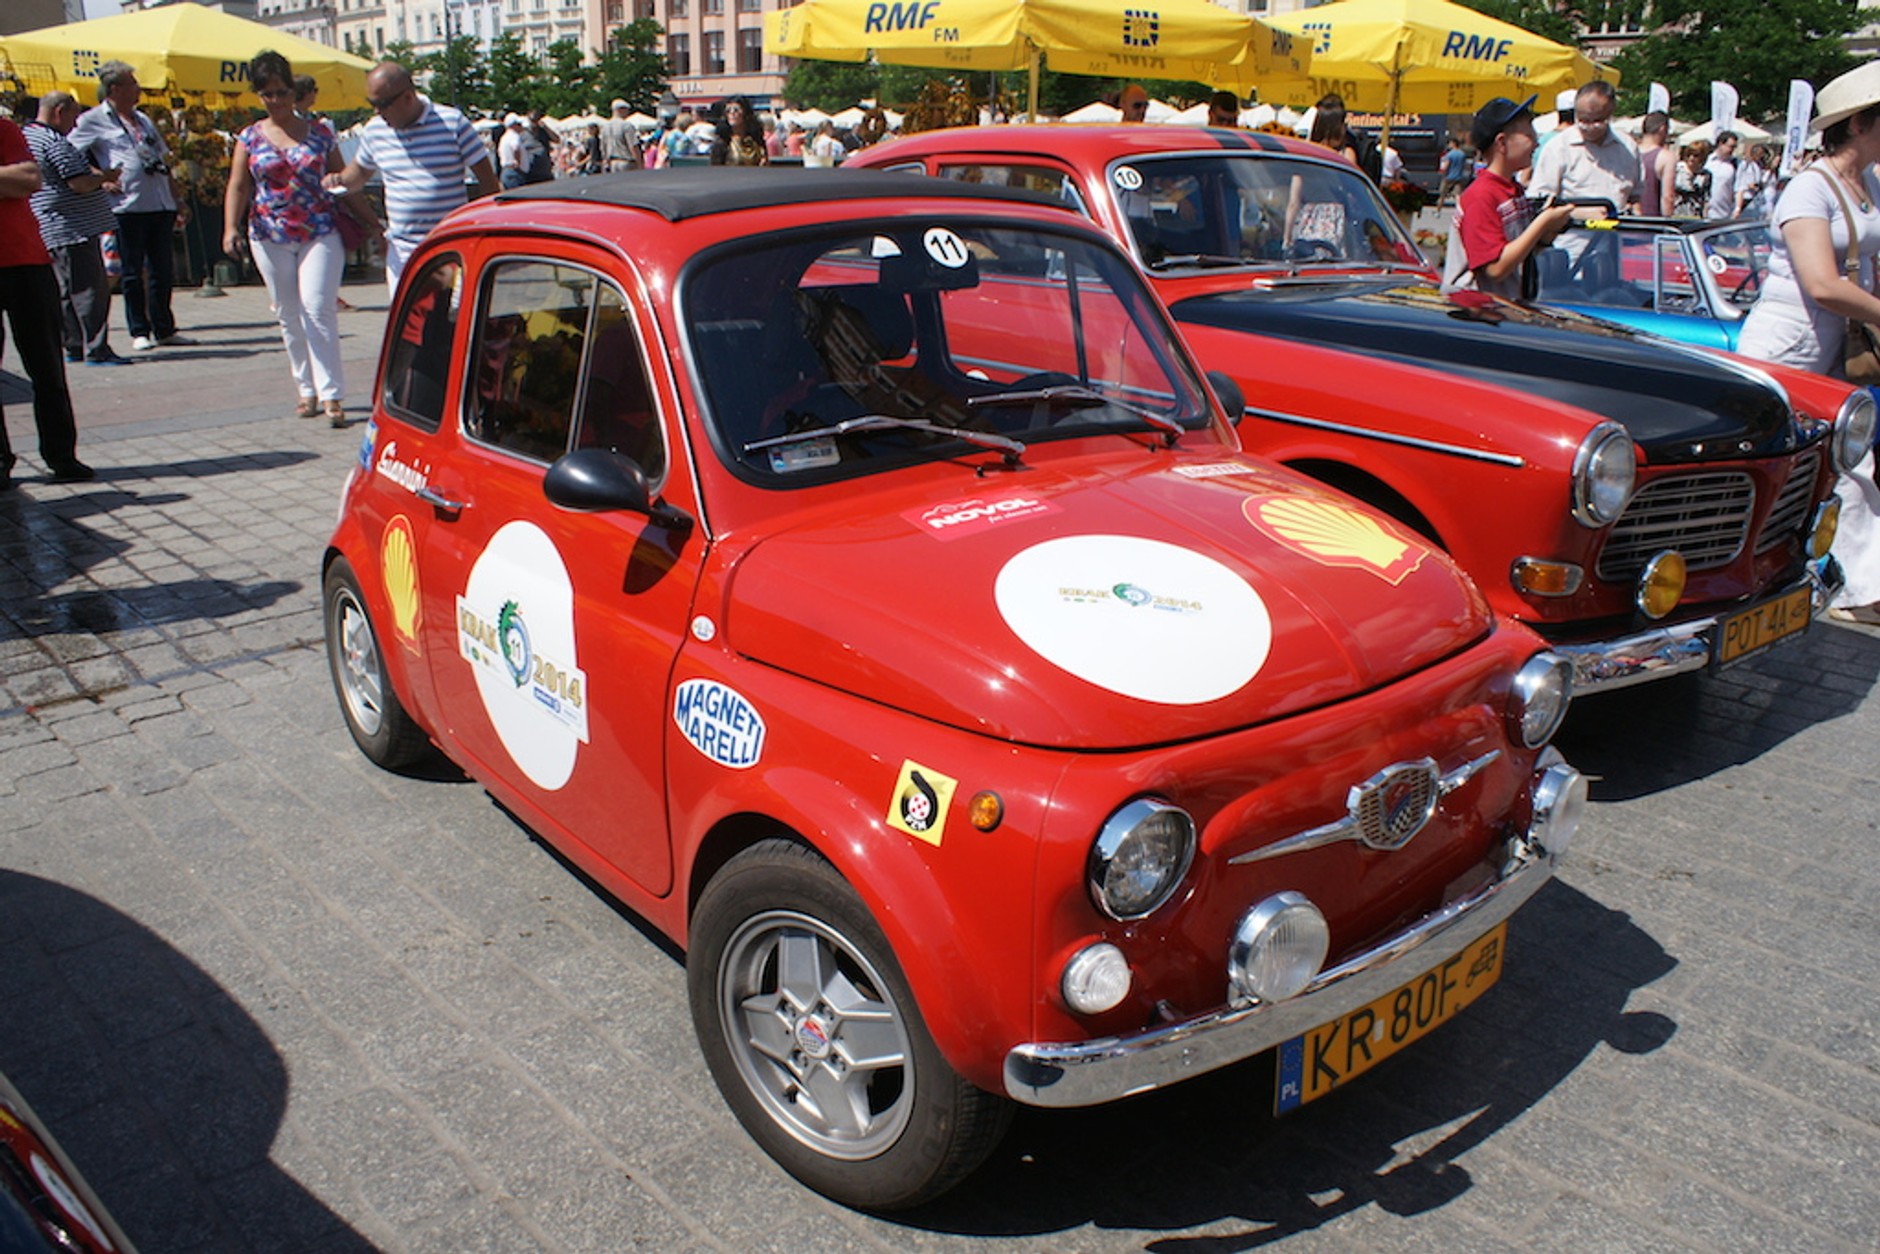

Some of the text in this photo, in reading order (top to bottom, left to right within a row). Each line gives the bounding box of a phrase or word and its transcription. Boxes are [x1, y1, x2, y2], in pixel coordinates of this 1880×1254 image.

[865, 2, 941, 33] RMF
[934, 28, 959, 42] FM
[1442, 31, 1513, 62] RMF
[220, 61, 252, 82] RM
[1505, 64, 1527, 78] FM
[1117, 170, 1139, 186] 10
[930, 234, 964, 261] 11
[928, 499, 1039, 529] NOVOL
[1724, 609, 1764, 658] POT
[532, 654, 583, 709] 2014
[1312, 955, 1464, 1092] KR 80F
[1281, 1081, 1299, 1101] PL
